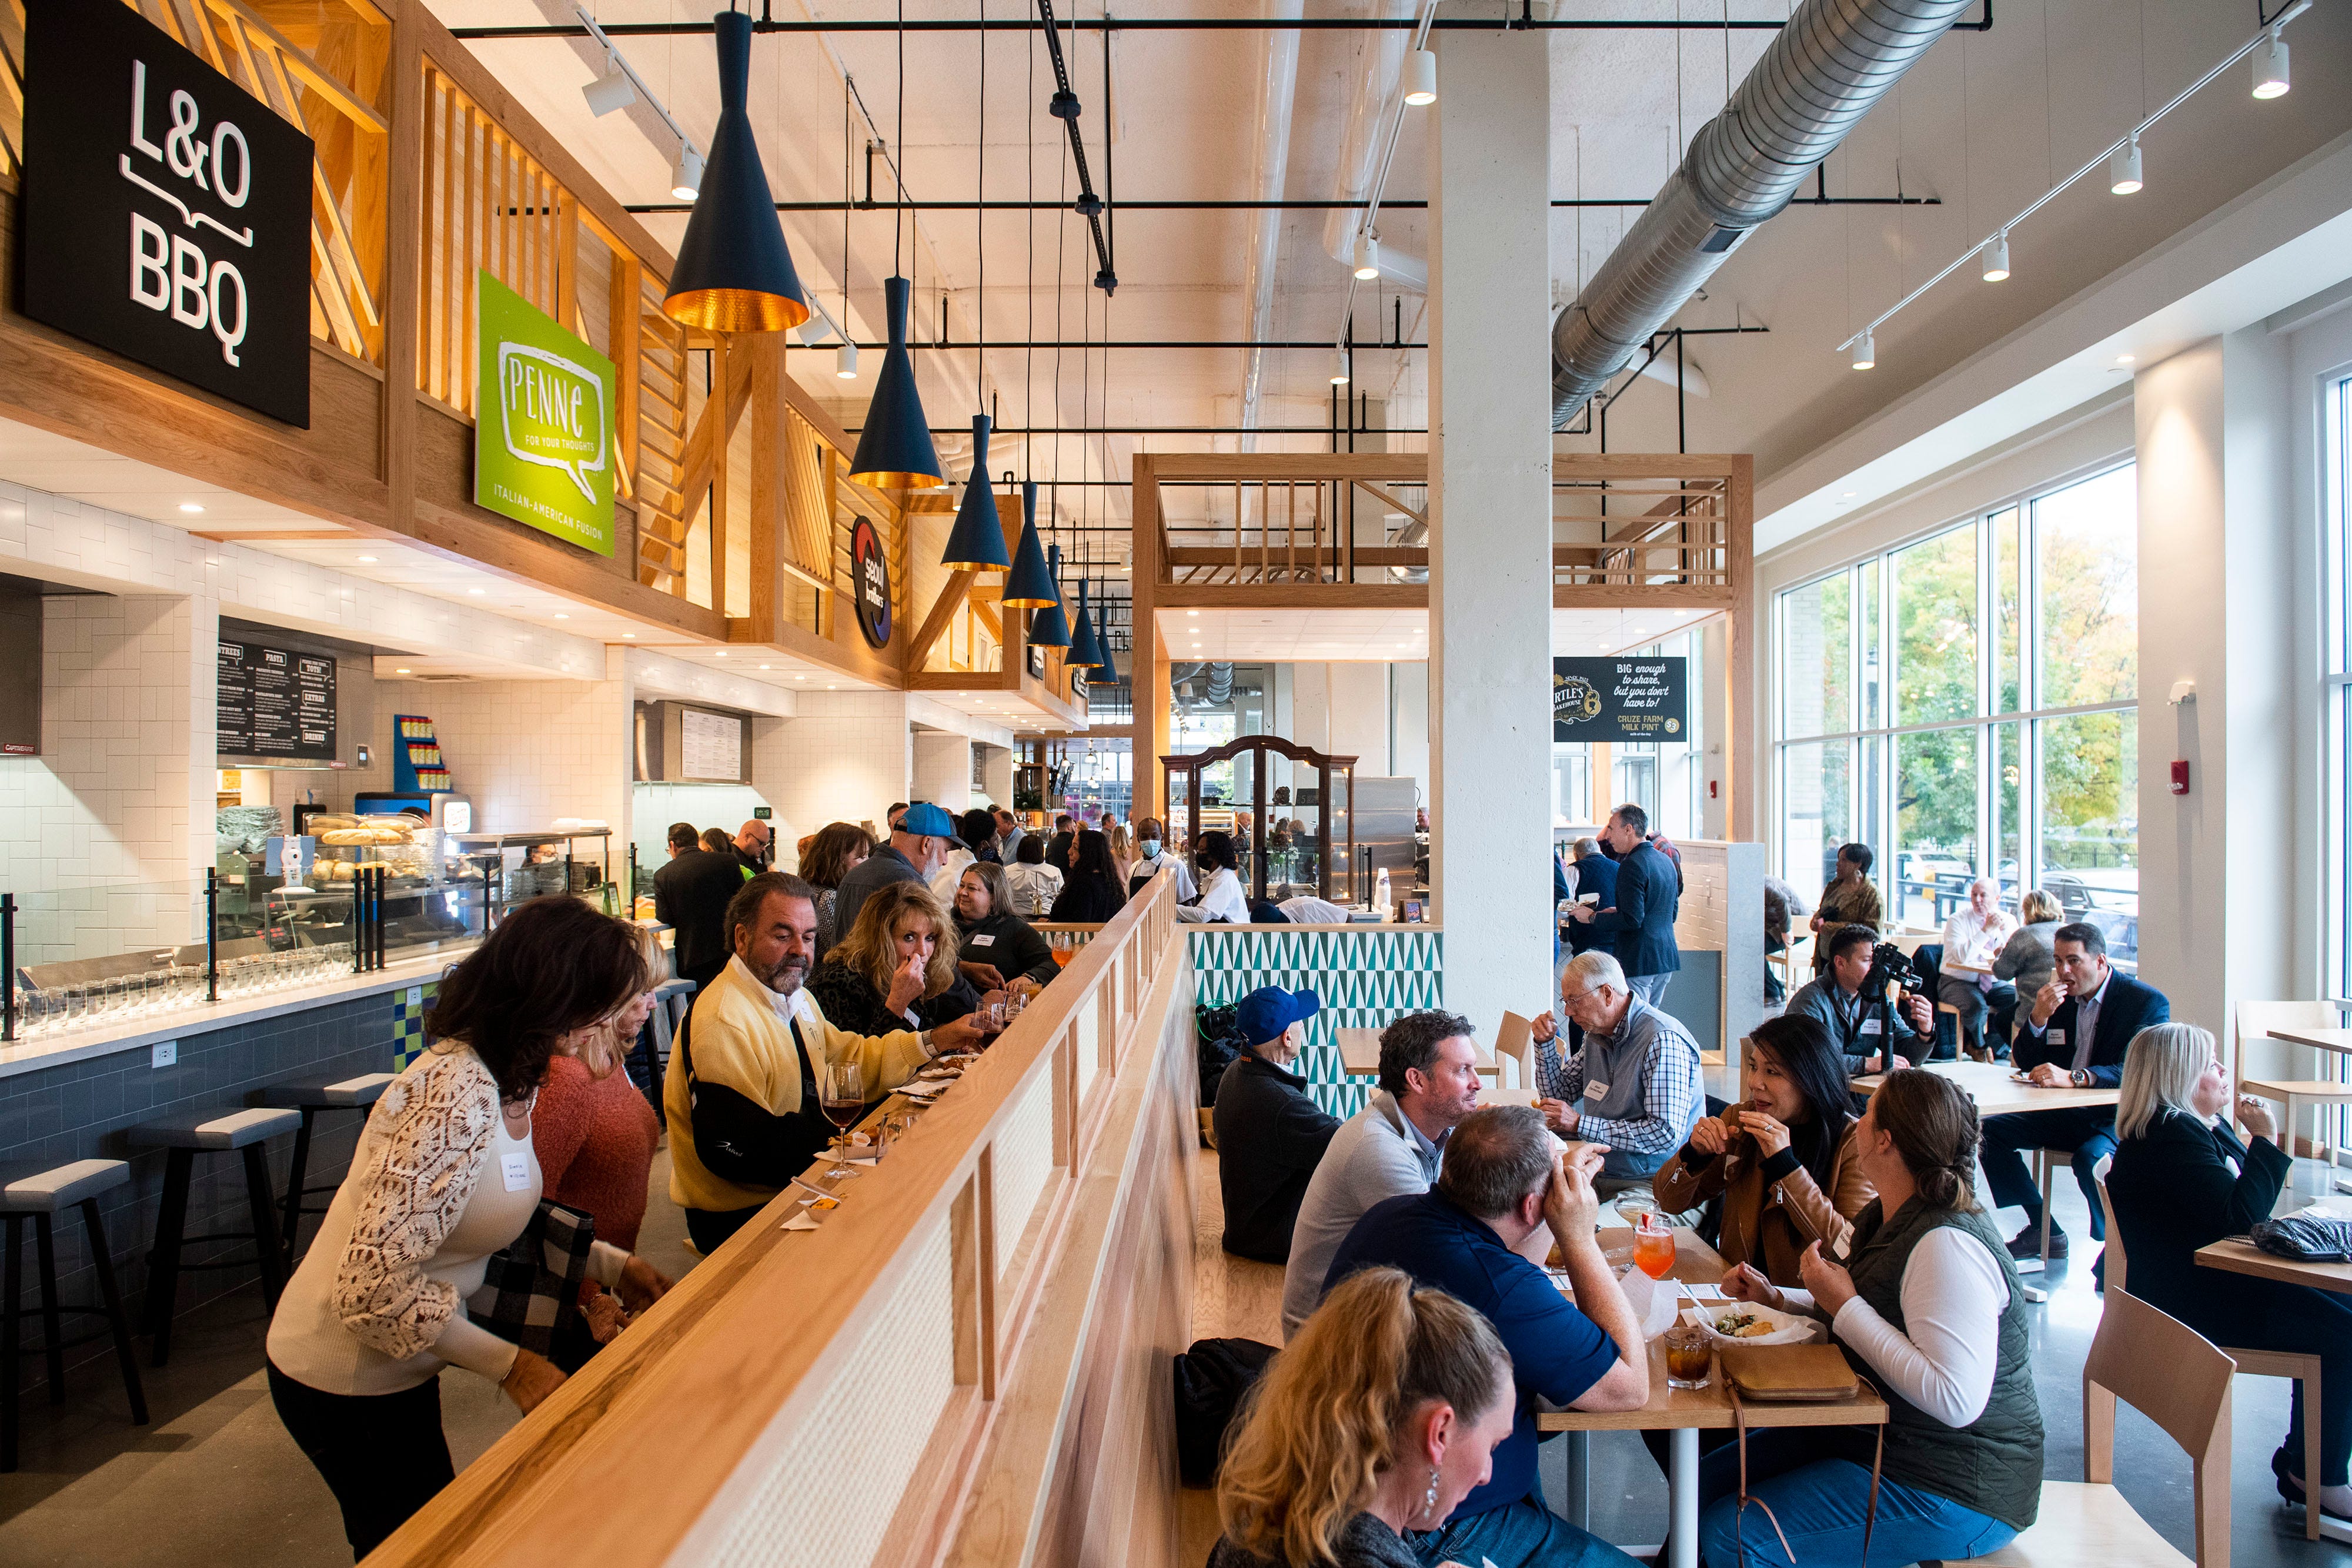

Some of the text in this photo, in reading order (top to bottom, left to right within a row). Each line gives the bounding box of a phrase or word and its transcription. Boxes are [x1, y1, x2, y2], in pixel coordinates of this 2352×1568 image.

[131, 59, 250, 208] L&O
[130, 212, 248, 367] BBQ
[526, 435, 594, 452] FOR YOUR THOUGHTS
[494, 483, 602, 540] ITALIAN-AMERICAN FUSION
[866, 556, 884, 591] seoul
[866, 580, 884, 608] brothers
[265, 653, 283, 663] PASTA
[1616, 663, 1666, 676] BIG enough
[1622, 674, 1660, 685] to share,
[305, 693, 325, 703] EXTRAS
[1613, 686, 1669, 698] but you don't
[1623, 697, 1660, 707] have to!
[305, 733, 325, 741] DRINKS
